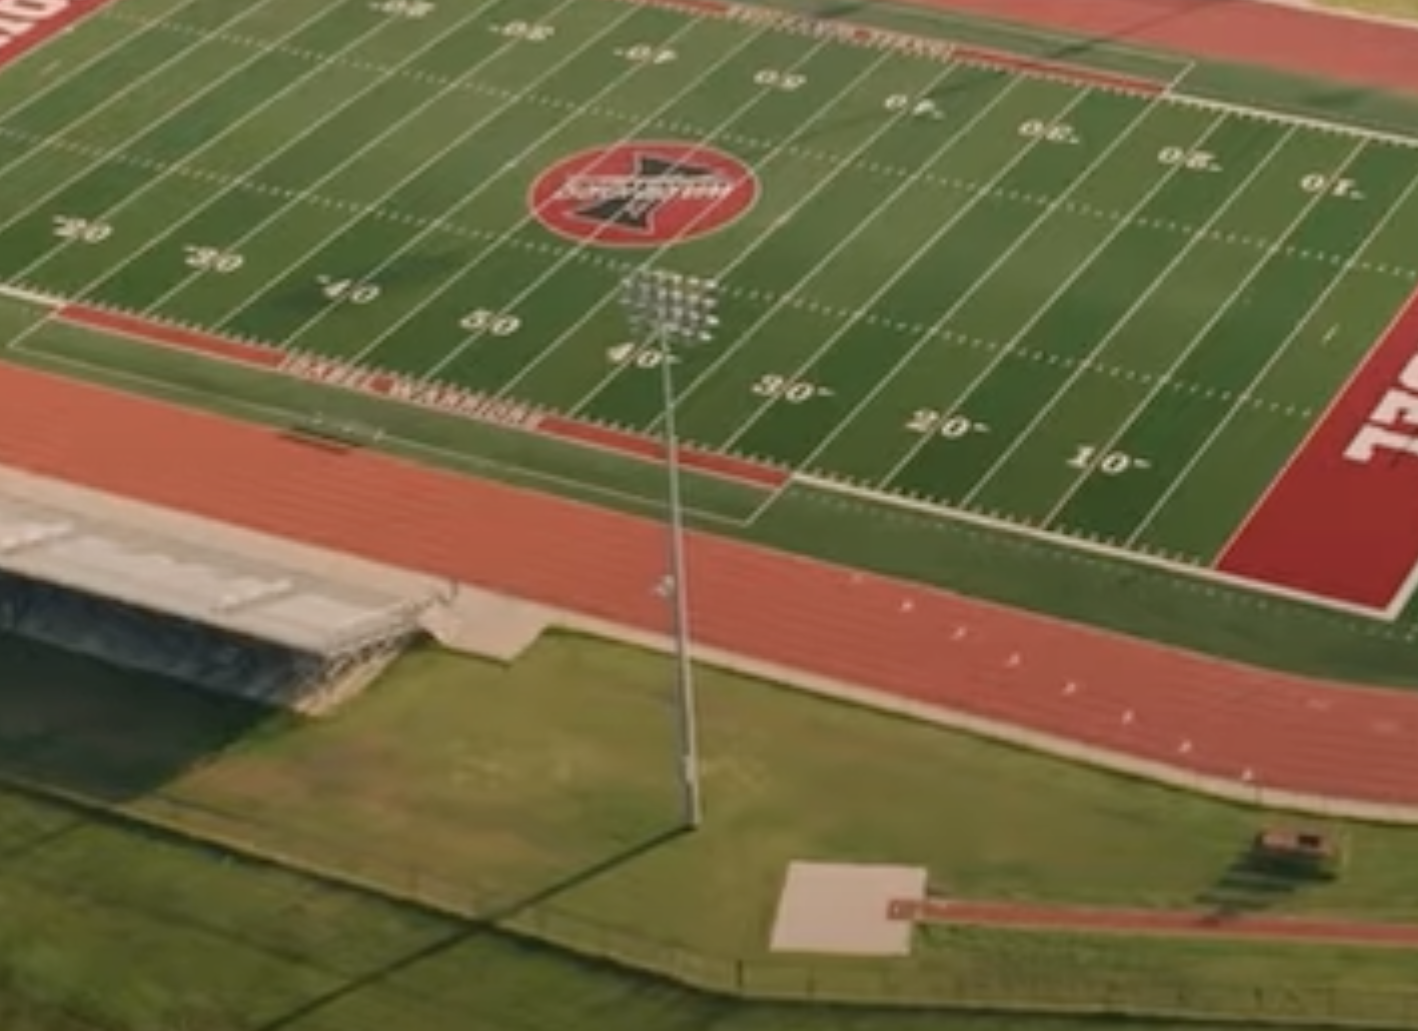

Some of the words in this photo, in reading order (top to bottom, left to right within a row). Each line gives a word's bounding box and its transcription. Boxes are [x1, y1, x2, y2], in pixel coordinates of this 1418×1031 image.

[460, 309, 521, 337] 50
[751, 373, 814, 403] 30
[905, 408, 971, 439] 20
[1066, 445, 1130, 475] 10
